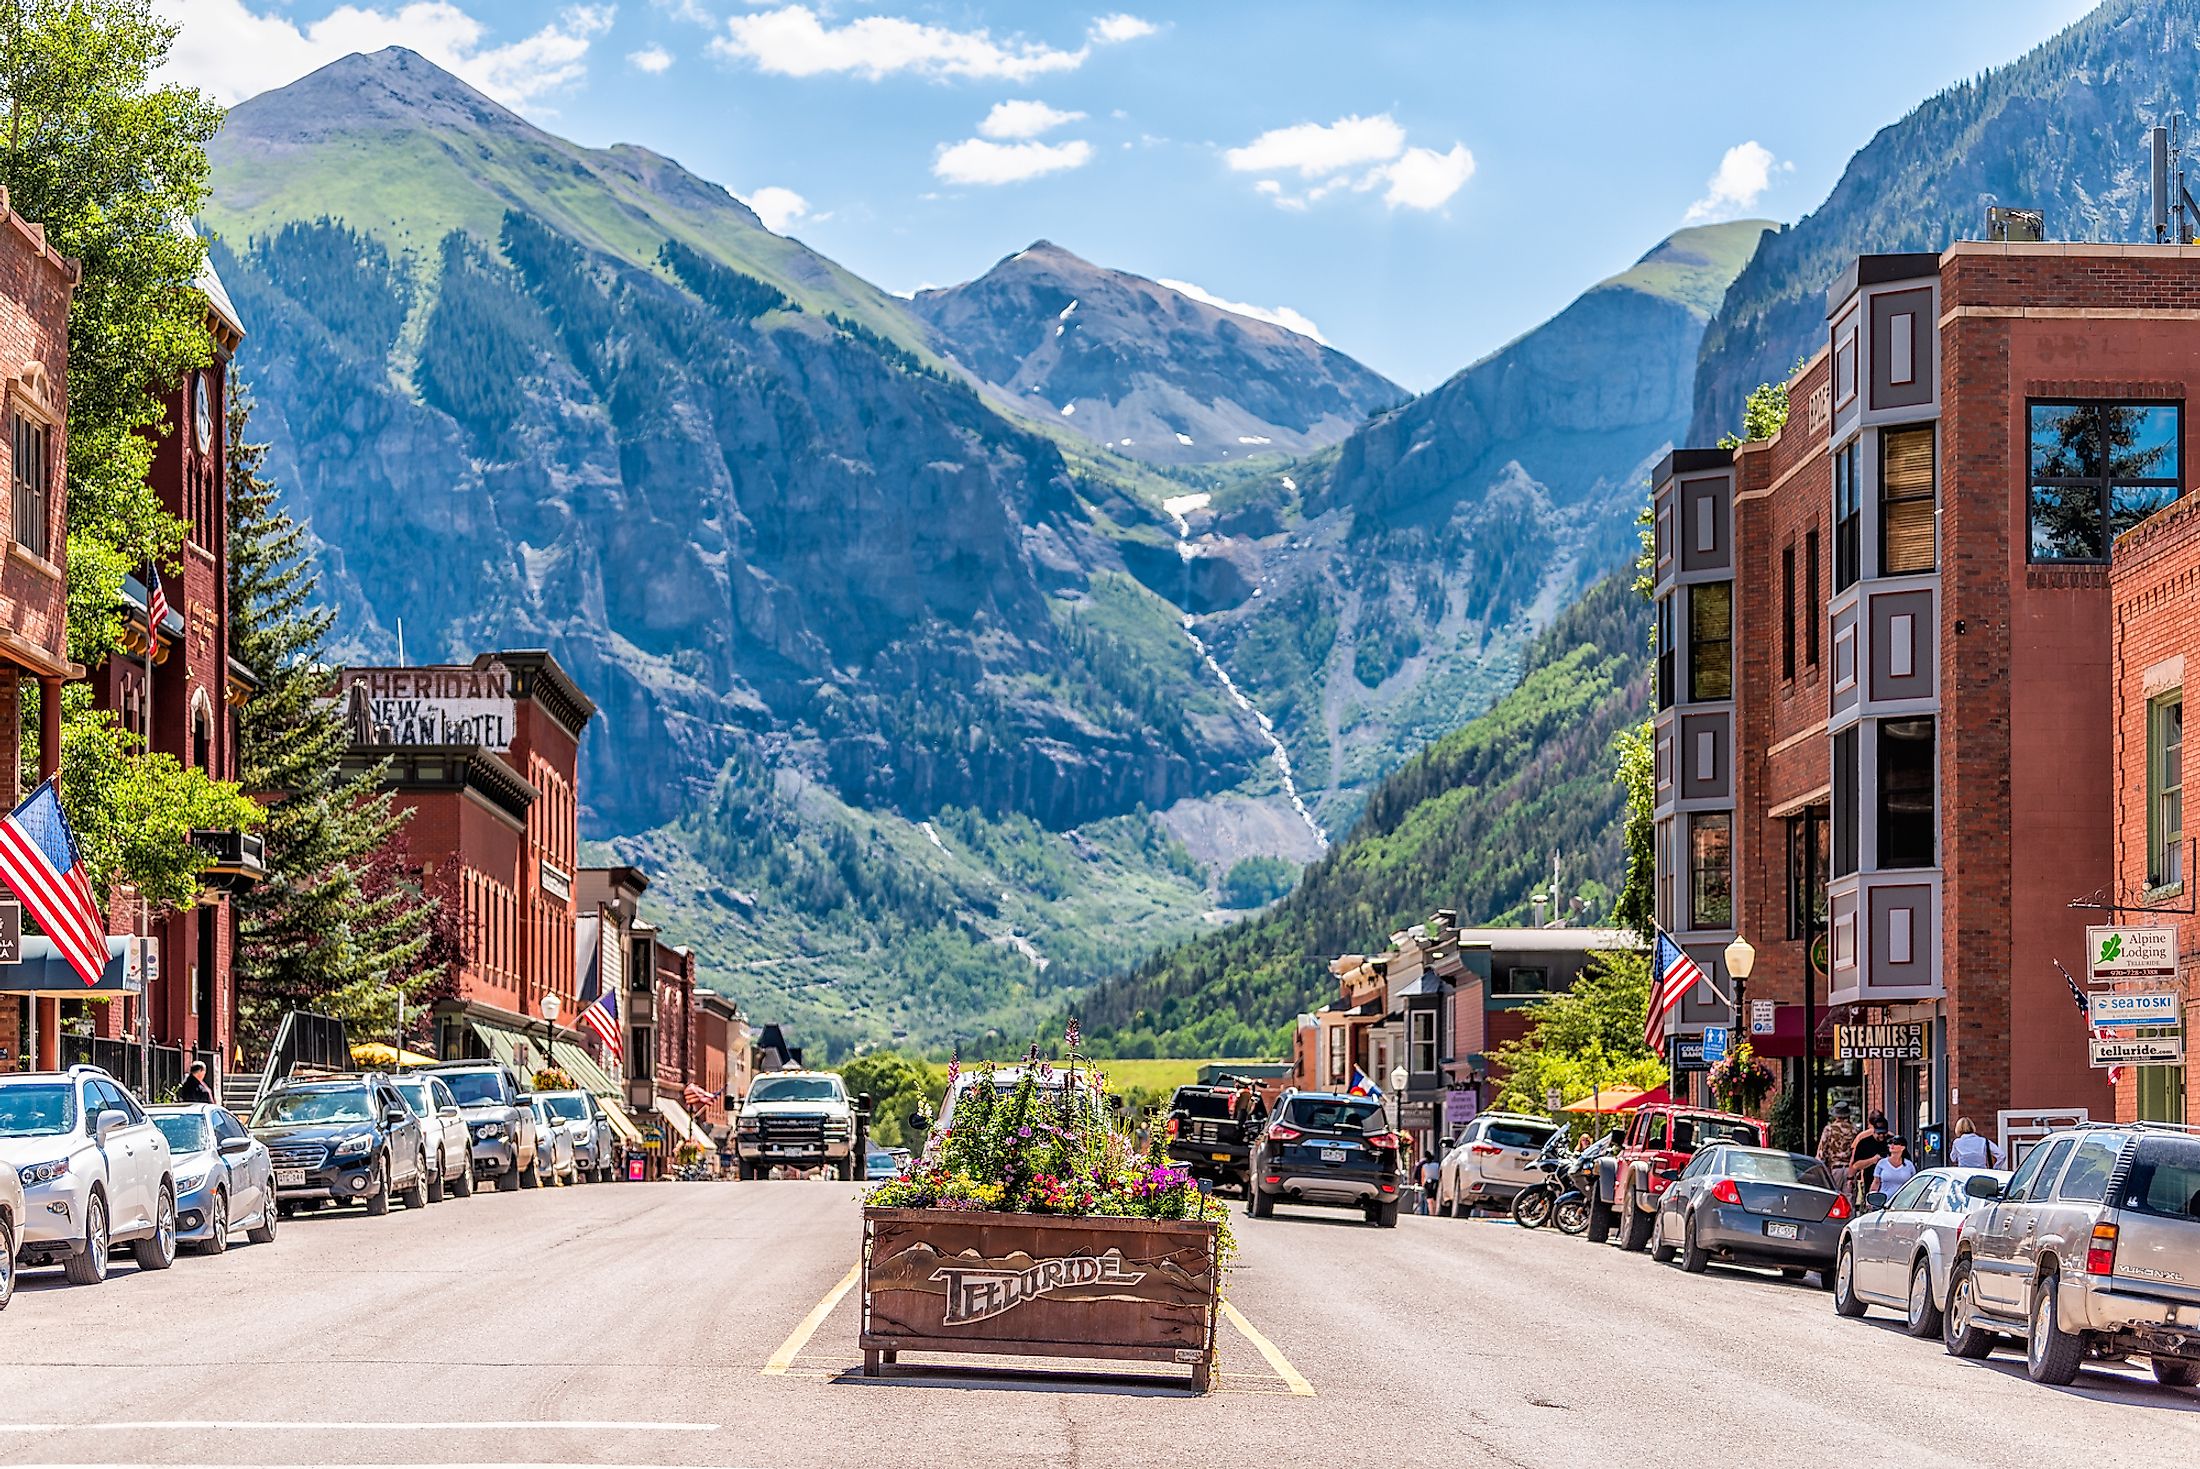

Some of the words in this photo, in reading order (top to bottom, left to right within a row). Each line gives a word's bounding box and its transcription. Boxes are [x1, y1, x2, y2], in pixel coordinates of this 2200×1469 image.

[446, 713, 508, 747] HOTEL
[2129, 933, 2166, 946] Alpine
[2121, 946, 2167, 960] Lodging
[2111, 998, 2134, 1009] sea
[2136, 998, 2151, 1008] TO
[2152, 997, 2171, 1007] SKI
[1840, 1025, 1908, 1047] STEAMIES
[1840, 1047, 1921, 1058] BURGER
[2100, 1045, 2173, 1056] telluride.com
[1930, 1134, 1939, 1147] P
[2118, 1264, 2164, 1278] YUKON
[2165, 1271, 2184, 1281] XL
[928, 1256, 1147, 1326] TELLURIDE
